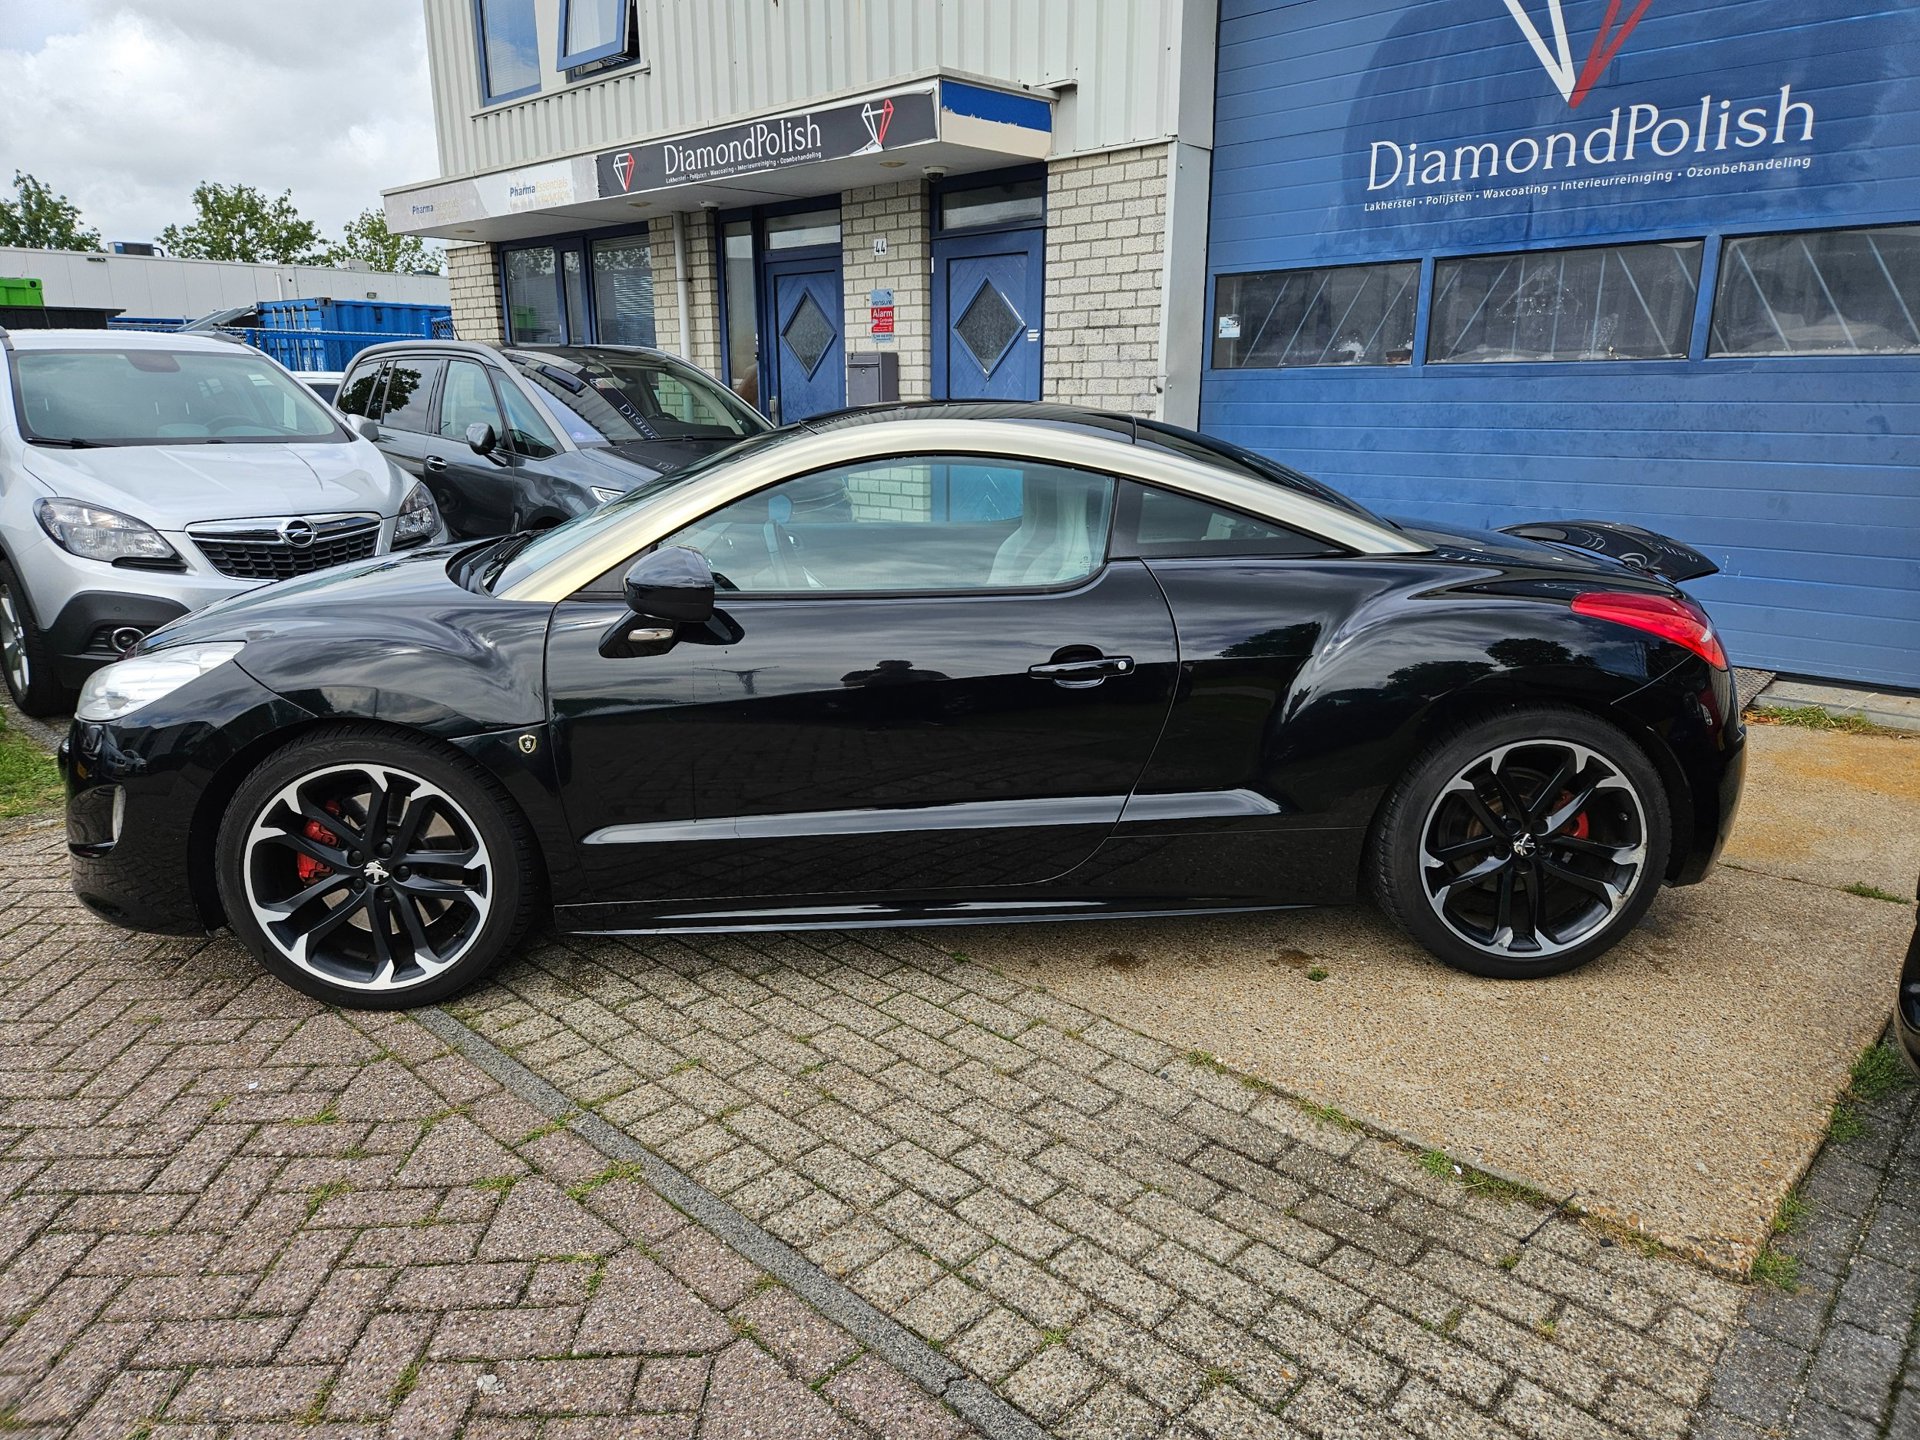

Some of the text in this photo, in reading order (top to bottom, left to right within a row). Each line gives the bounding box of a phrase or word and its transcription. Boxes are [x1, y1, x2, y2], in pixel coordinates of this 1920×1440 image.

[663, 114, 822, 175] DiamondPolish
[1367, 84, 1815, 193] DiamondPolish
[779, 151, 822, 164] Ozonbehandeling
[1364, 156, 1812, 212] Lakherstel Polijsten Waxcoating Interieurreiniging Ozonbehandeling
[509, 185, 536, 197] Pharma
[412, 204, 434, 215] Pharma
[875, 240, 886, 254] 44
[872, 309, 893, 318] Alarm
